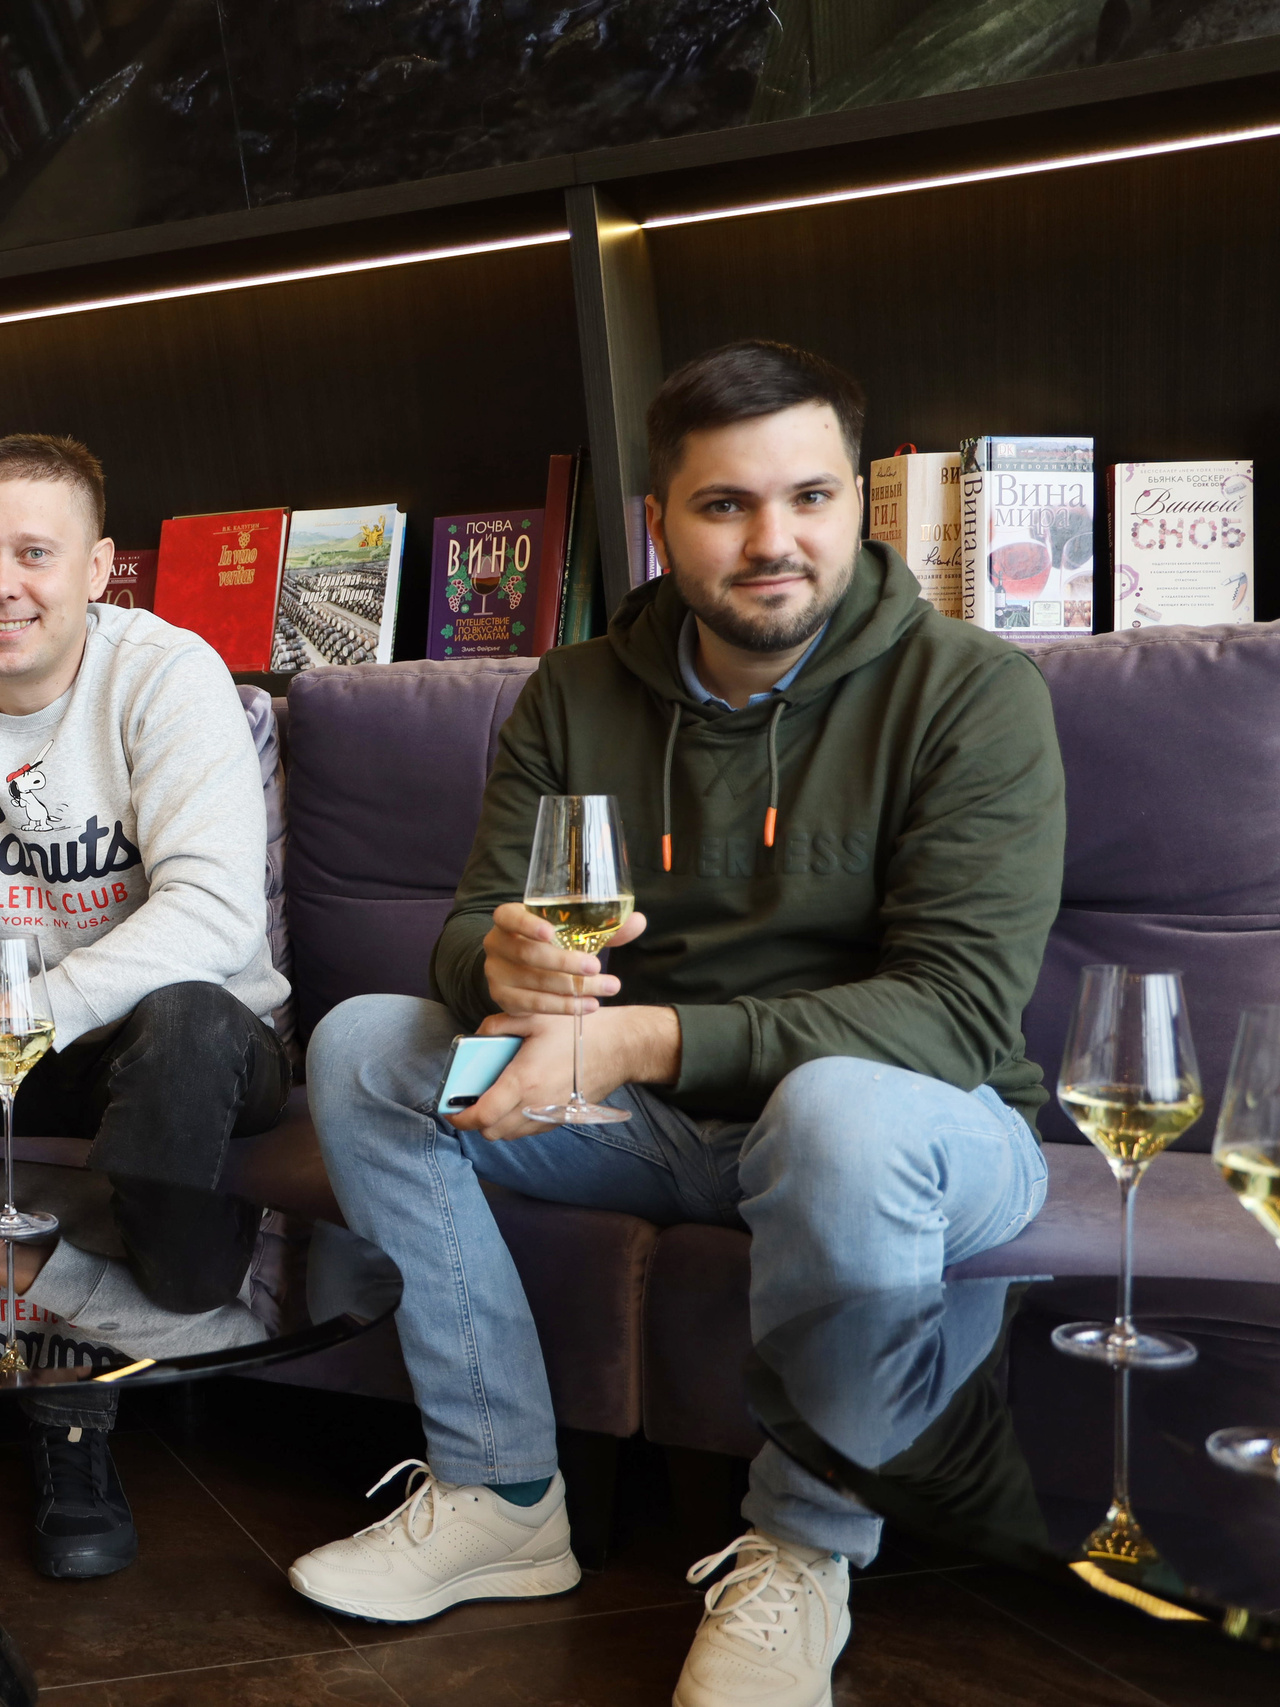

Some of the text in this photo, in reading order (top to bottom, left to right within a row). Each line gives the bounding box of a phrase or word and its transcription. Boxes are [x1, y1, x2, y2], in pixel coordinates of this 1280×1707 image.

[999, 445, 1015, 455] DK
[997, 463, 1088, 471] ПУТЕВОДИТЕЛЬ
[1148, 475, 1225, 483] БЬЯНКА БОСКЕР
[871, 482, 902, 501] ВИННЫЙ
[994, 473, 1087, 508] Вина
[1130, 487, 1247, 520] Винный
[874, 502, 898, 528] ГИД
[994, 507, 1070, 536] мира
[466, 520, 513, 534] ПОЧВА
[485, 533, 493, 541] И
[1131, 517, 1246, 550] СНОБ
[218, 545, 257, 566] In vino
[447, 534, 531, 577] ВИНО
[962, 476, 983, 620] Вина мира
[219, 565, 255, 587] veritas
[456, 617, 510, 627] ПУТЕШЕСТВИЕ
[472, 626, 507, 634] ВКУСАМ
[462, 633, 510, 641] АРОМАТАМ
[62, 881, 128, 914] CLUB
